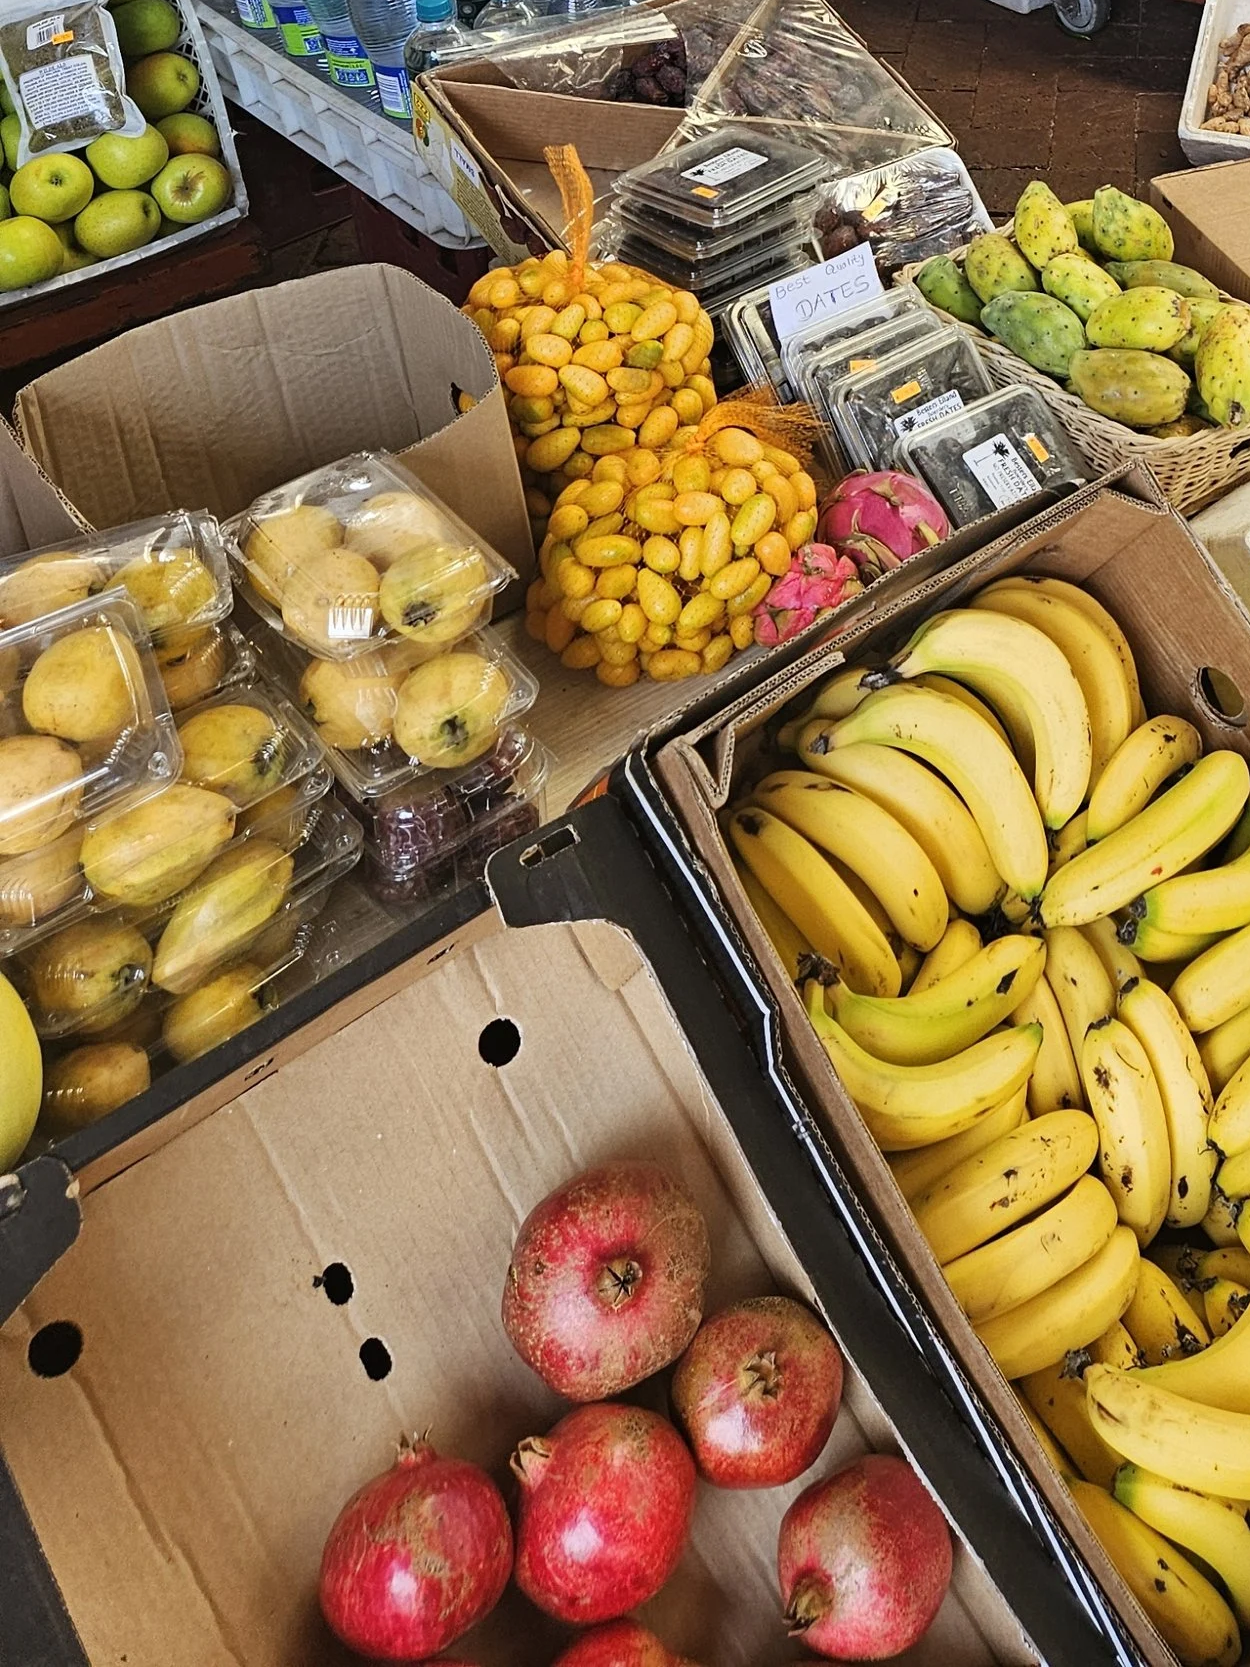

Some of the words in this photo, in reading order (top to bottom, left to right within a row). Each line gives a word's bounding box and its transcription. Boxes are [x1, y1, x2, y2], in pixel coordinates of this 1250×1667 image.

[775, 274, 811, 300] Best
[824, 253, 865, 276] Quality
[795, 274, 870, 322] DATES
[939, 404, 962, 419] DATES
[998, 458, 1015, 483] FRESH
[1013, 481, 1028, 497] DAT
